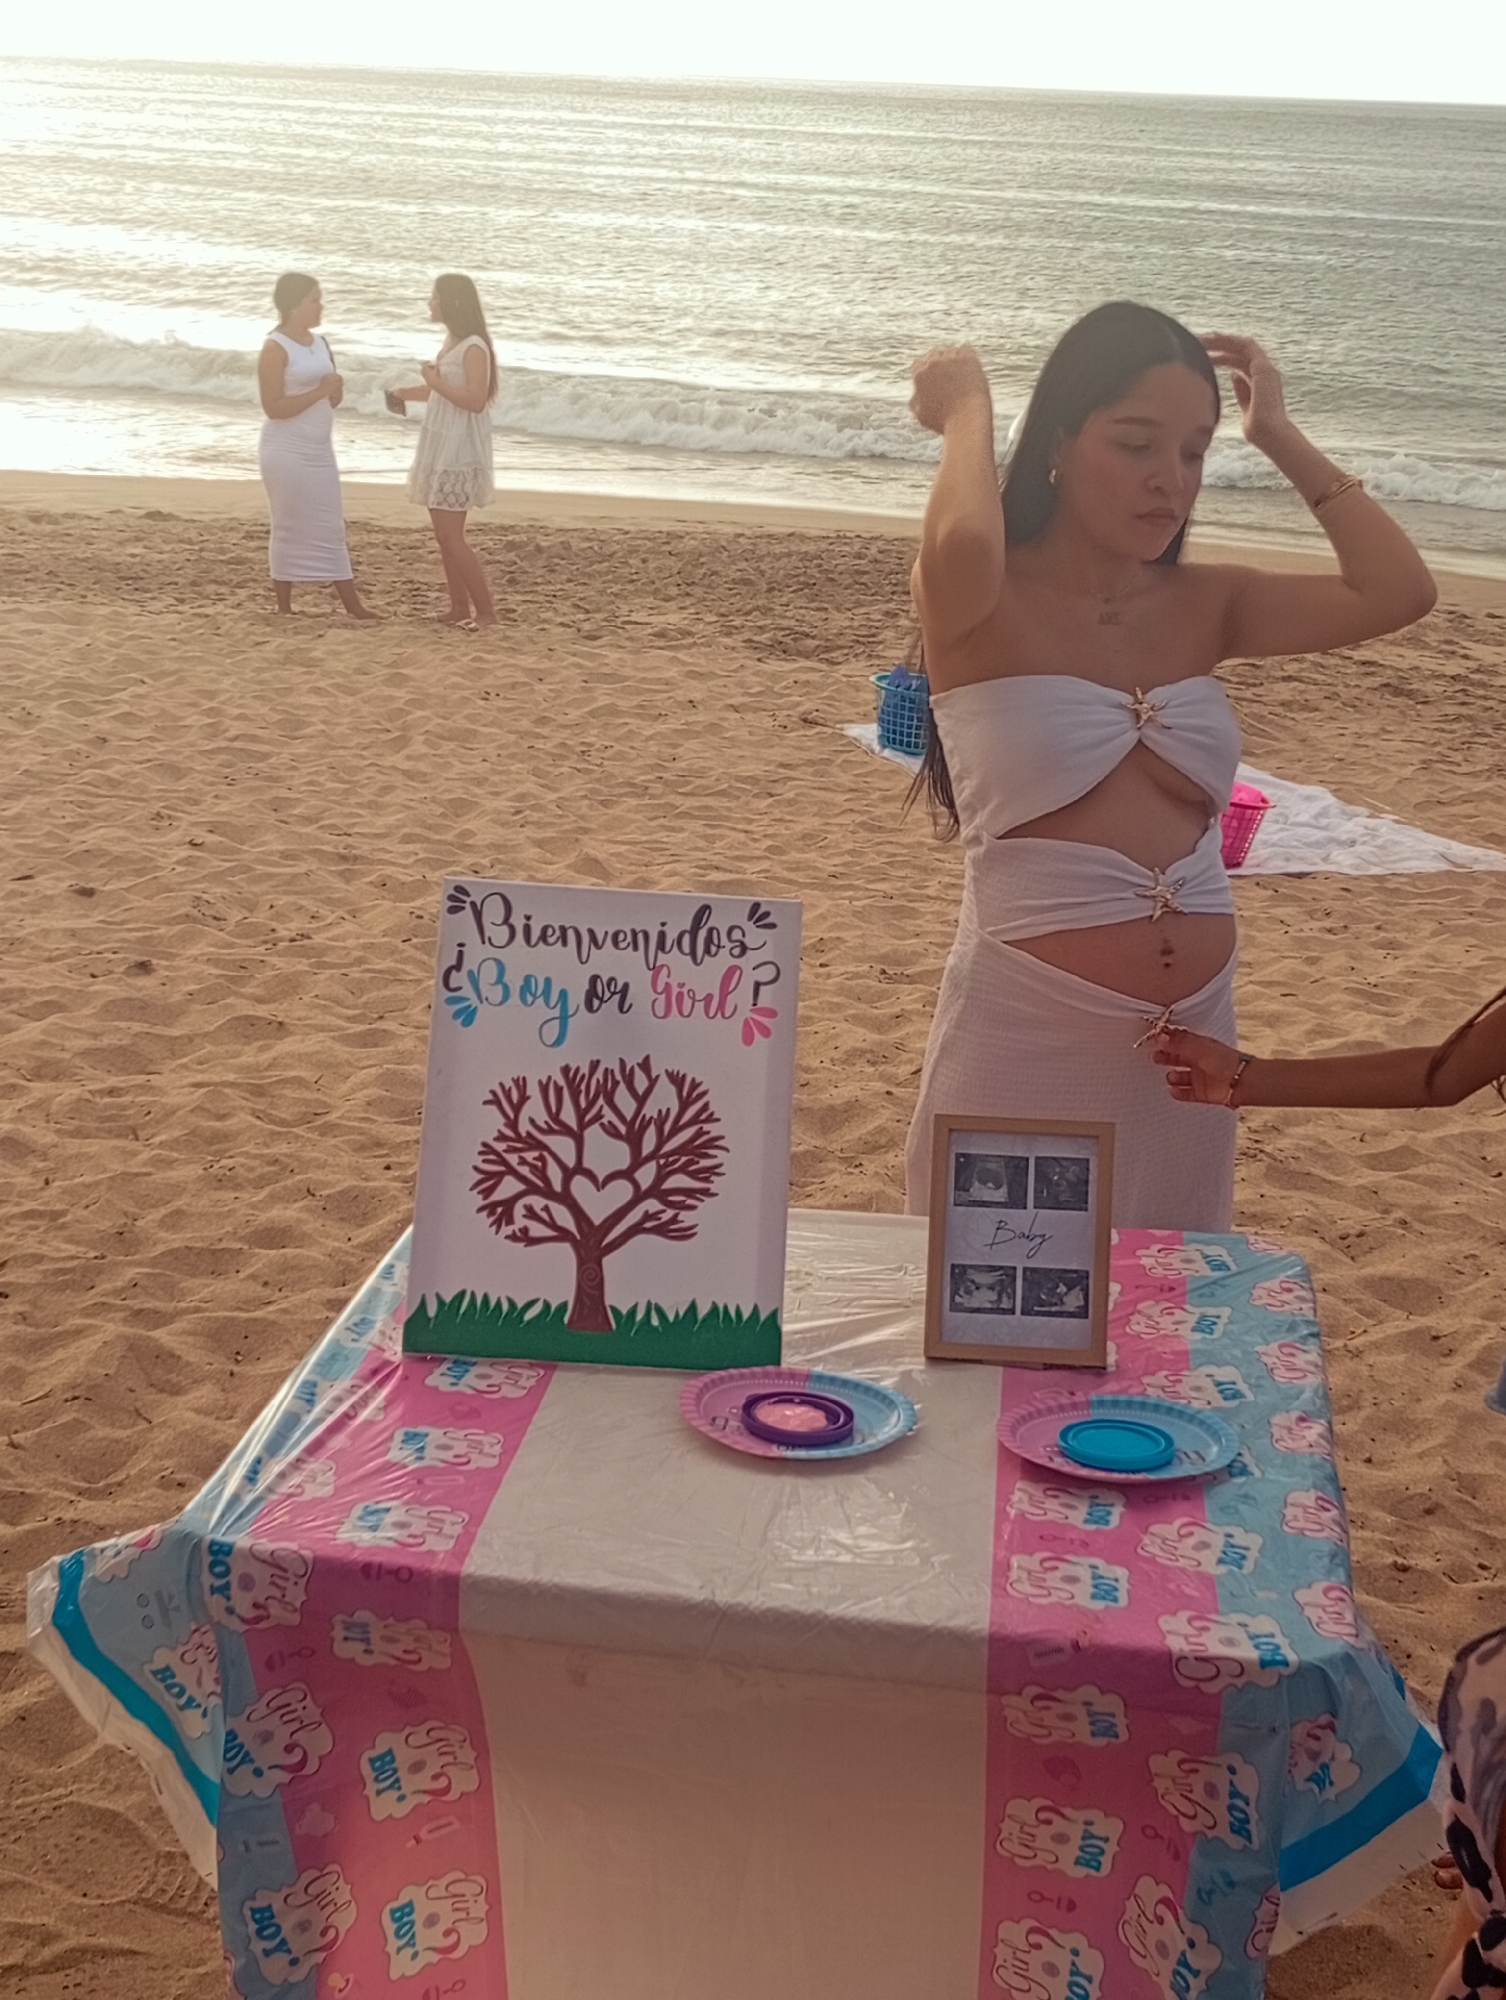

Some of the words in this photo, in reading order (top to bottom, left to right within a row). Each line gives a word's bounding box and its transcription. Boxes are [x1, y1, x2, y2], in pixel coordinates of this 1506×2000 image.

[469, 892, 767, 970] Bienvenidos
[584, 973, 634, 1014] or
[983, 1211, 1054, 1259] Baby
[208, 1538, 236, 1601] BOY
[150, 1662, 203, 1712] BOY
[367, 1746, 403, 1798] BOY
[1073, 1828, 1111, 1873] BOY
[282, 1869, 353, 1923] Girl
[425, 1878, 485, 1926] Girl
[249, 1902, 293, 1957] BOY
[389, 1898, 416, 1956] BOY
